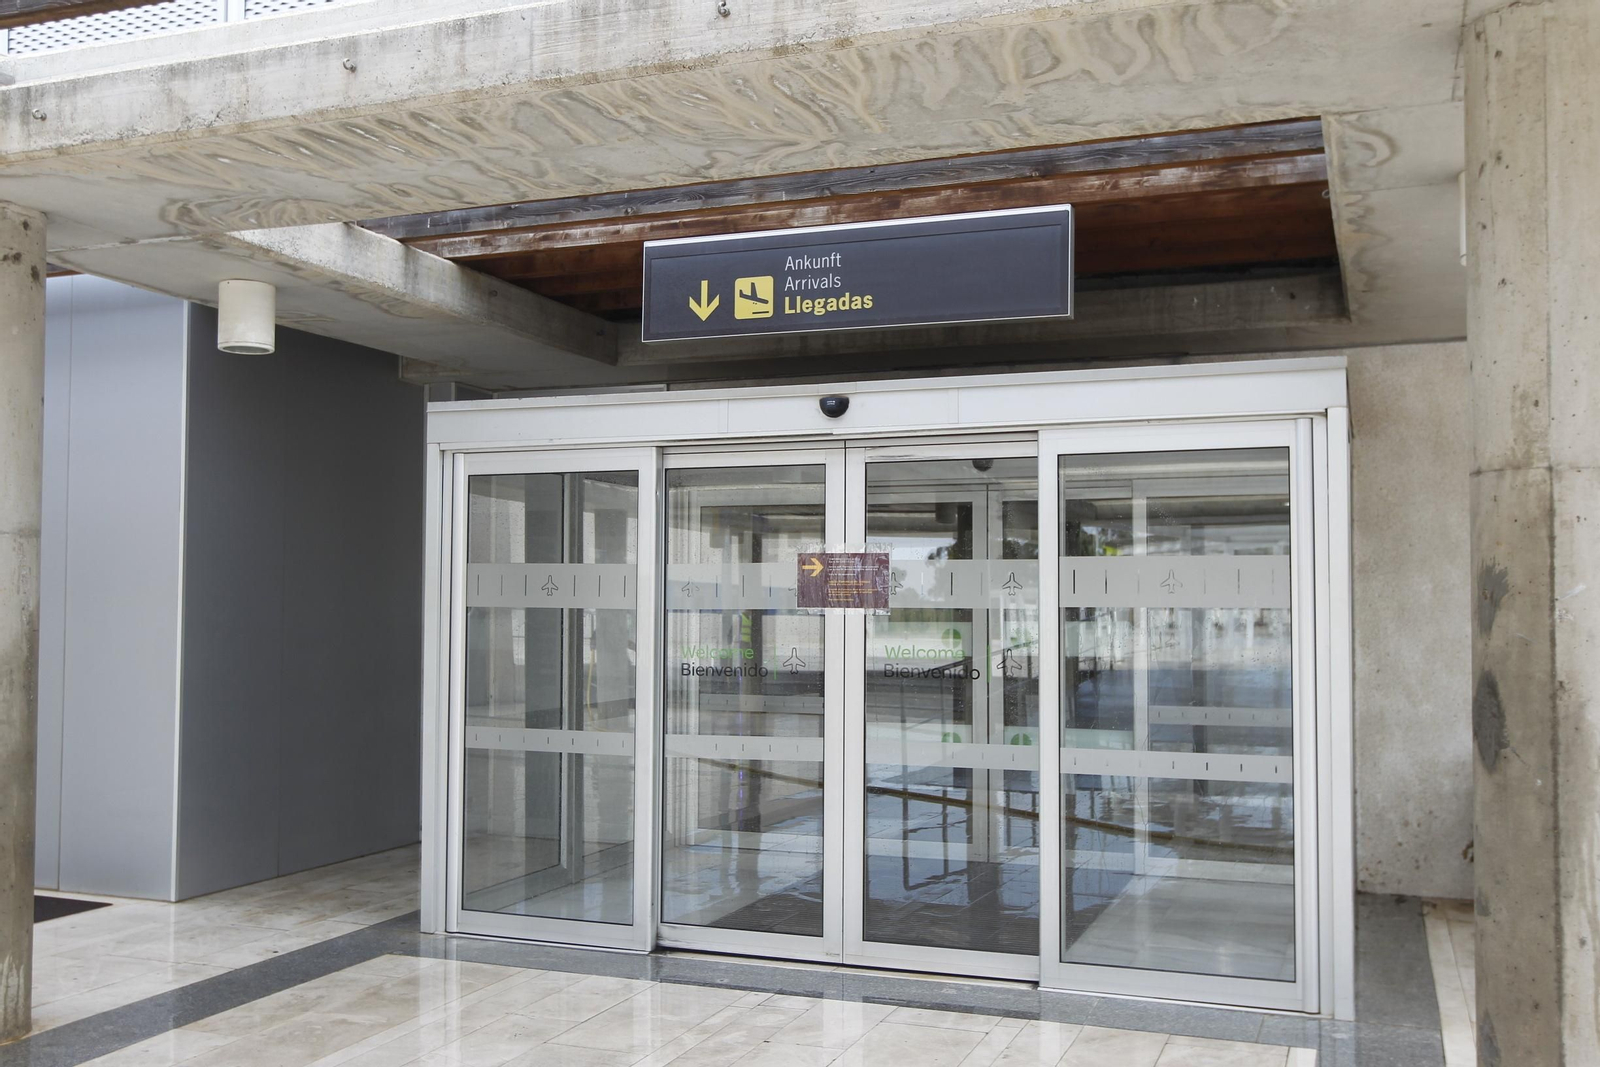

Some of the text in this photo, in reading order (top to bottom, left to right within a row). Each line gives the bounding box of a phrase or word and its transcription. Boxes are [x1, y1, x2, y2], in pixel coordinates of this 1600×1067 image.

[785, 252, 841, 271] Ankunft
[785, 273, 841, 291] Arrivals
[785, 292, 873, 316] Llegadas
[681, 644, 754, 659] Welcome
[884, 644, 966, 660] Welcome
[681, 662, 768, 678] Bienvenido
[883, 663, 981, 680] Bienvenido
